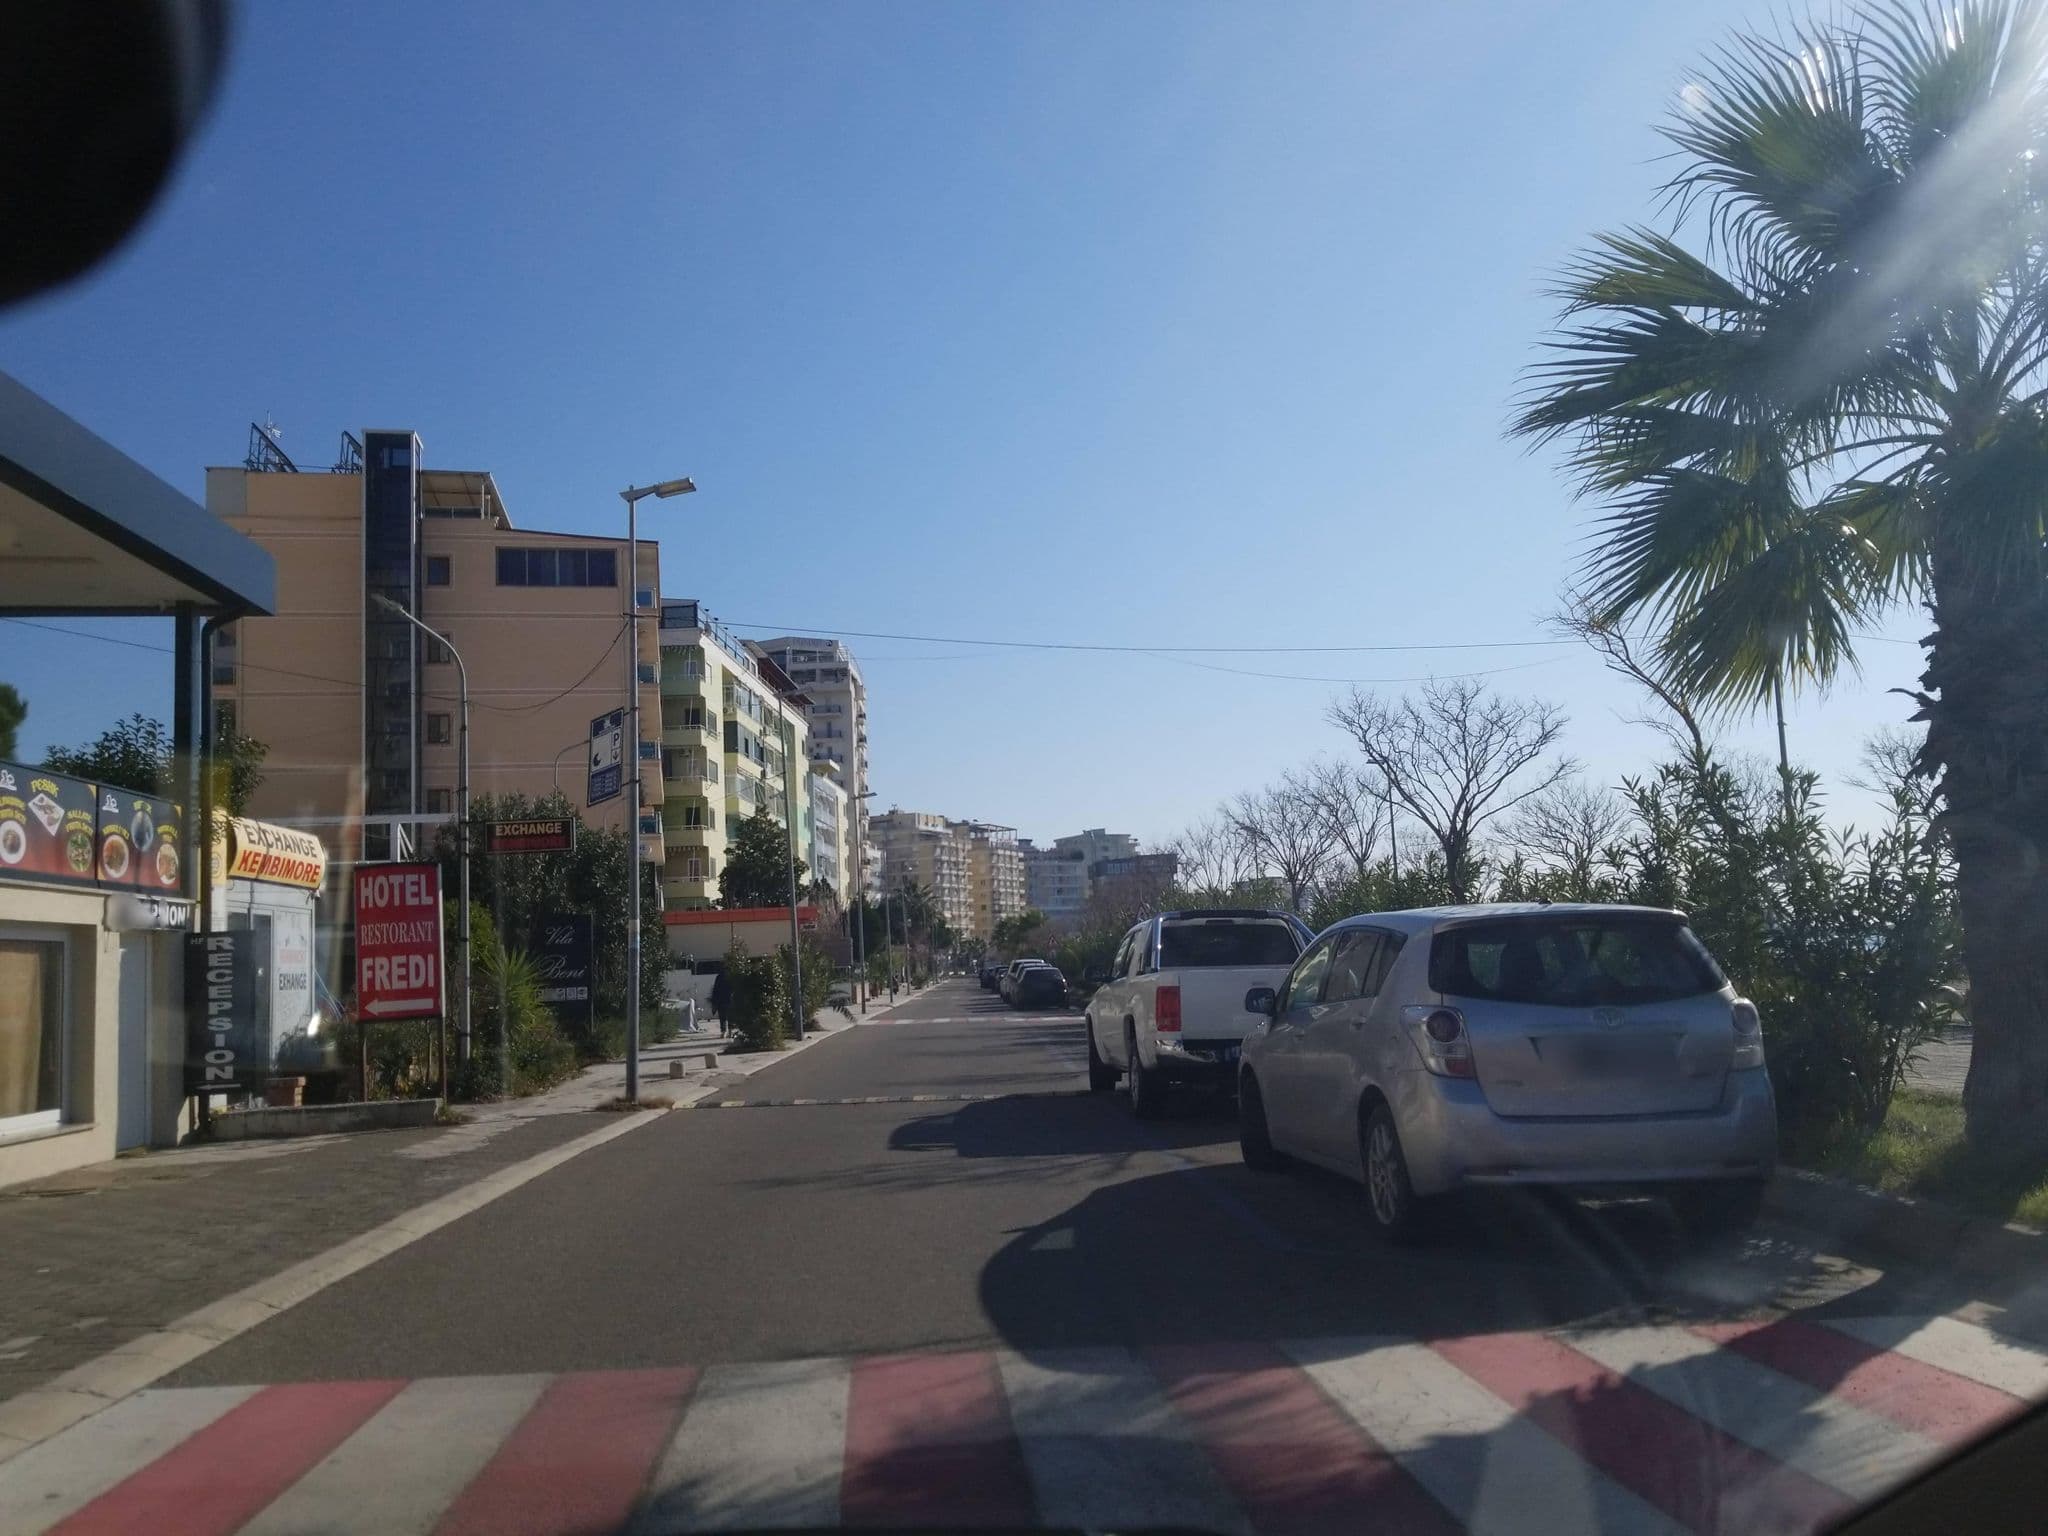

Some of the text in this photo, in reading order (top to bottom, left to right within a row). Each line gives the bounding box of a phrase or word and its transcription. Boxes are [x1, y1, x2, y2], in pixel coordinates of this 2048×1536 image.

[613, 733, 620, 746] P
[243, 824, 317, 857] EXCHANGE
[496, 823, 562, 836] EXCHANGE
[238, 850, 321, 883] KEMBIMORE
[360, 874, 433, 909] HOTEL
[361, 921, 433, 946] RESTORANT
[362, 954, 434, 992] FREDI
[205, 937, 235, 1080] RECEPSION
